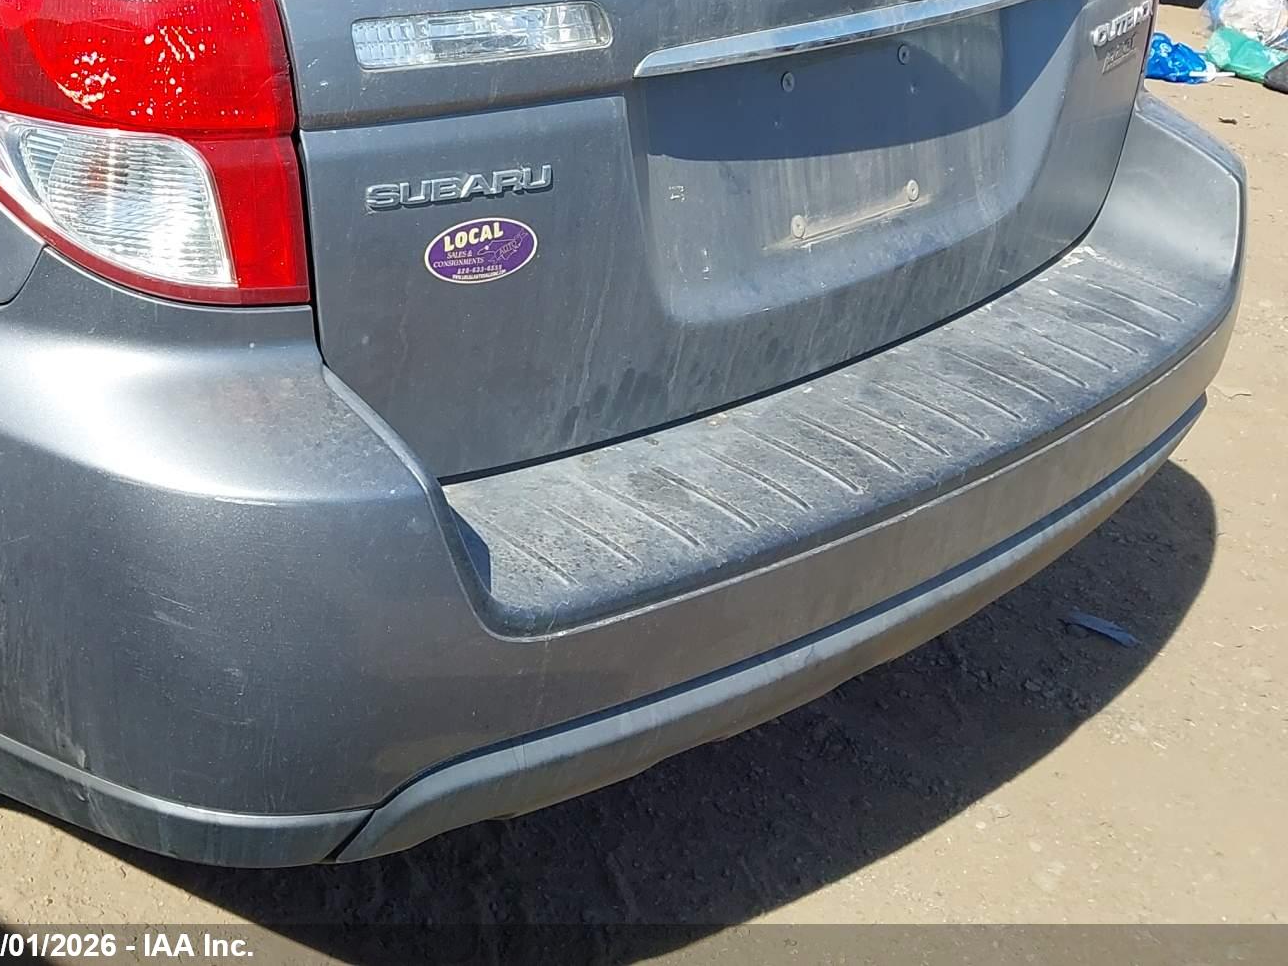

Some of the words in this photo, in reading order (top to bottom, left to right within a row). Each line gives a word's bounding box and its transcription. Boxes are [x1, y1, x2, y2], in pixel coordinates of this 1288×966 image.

[365, 164, 553, 208] SUBARU
[443, 221, 504, 252] LOCAL
[433, 256, 485, 269] CONSIGNMENTS
[446, 251, 468, 260] SALES
